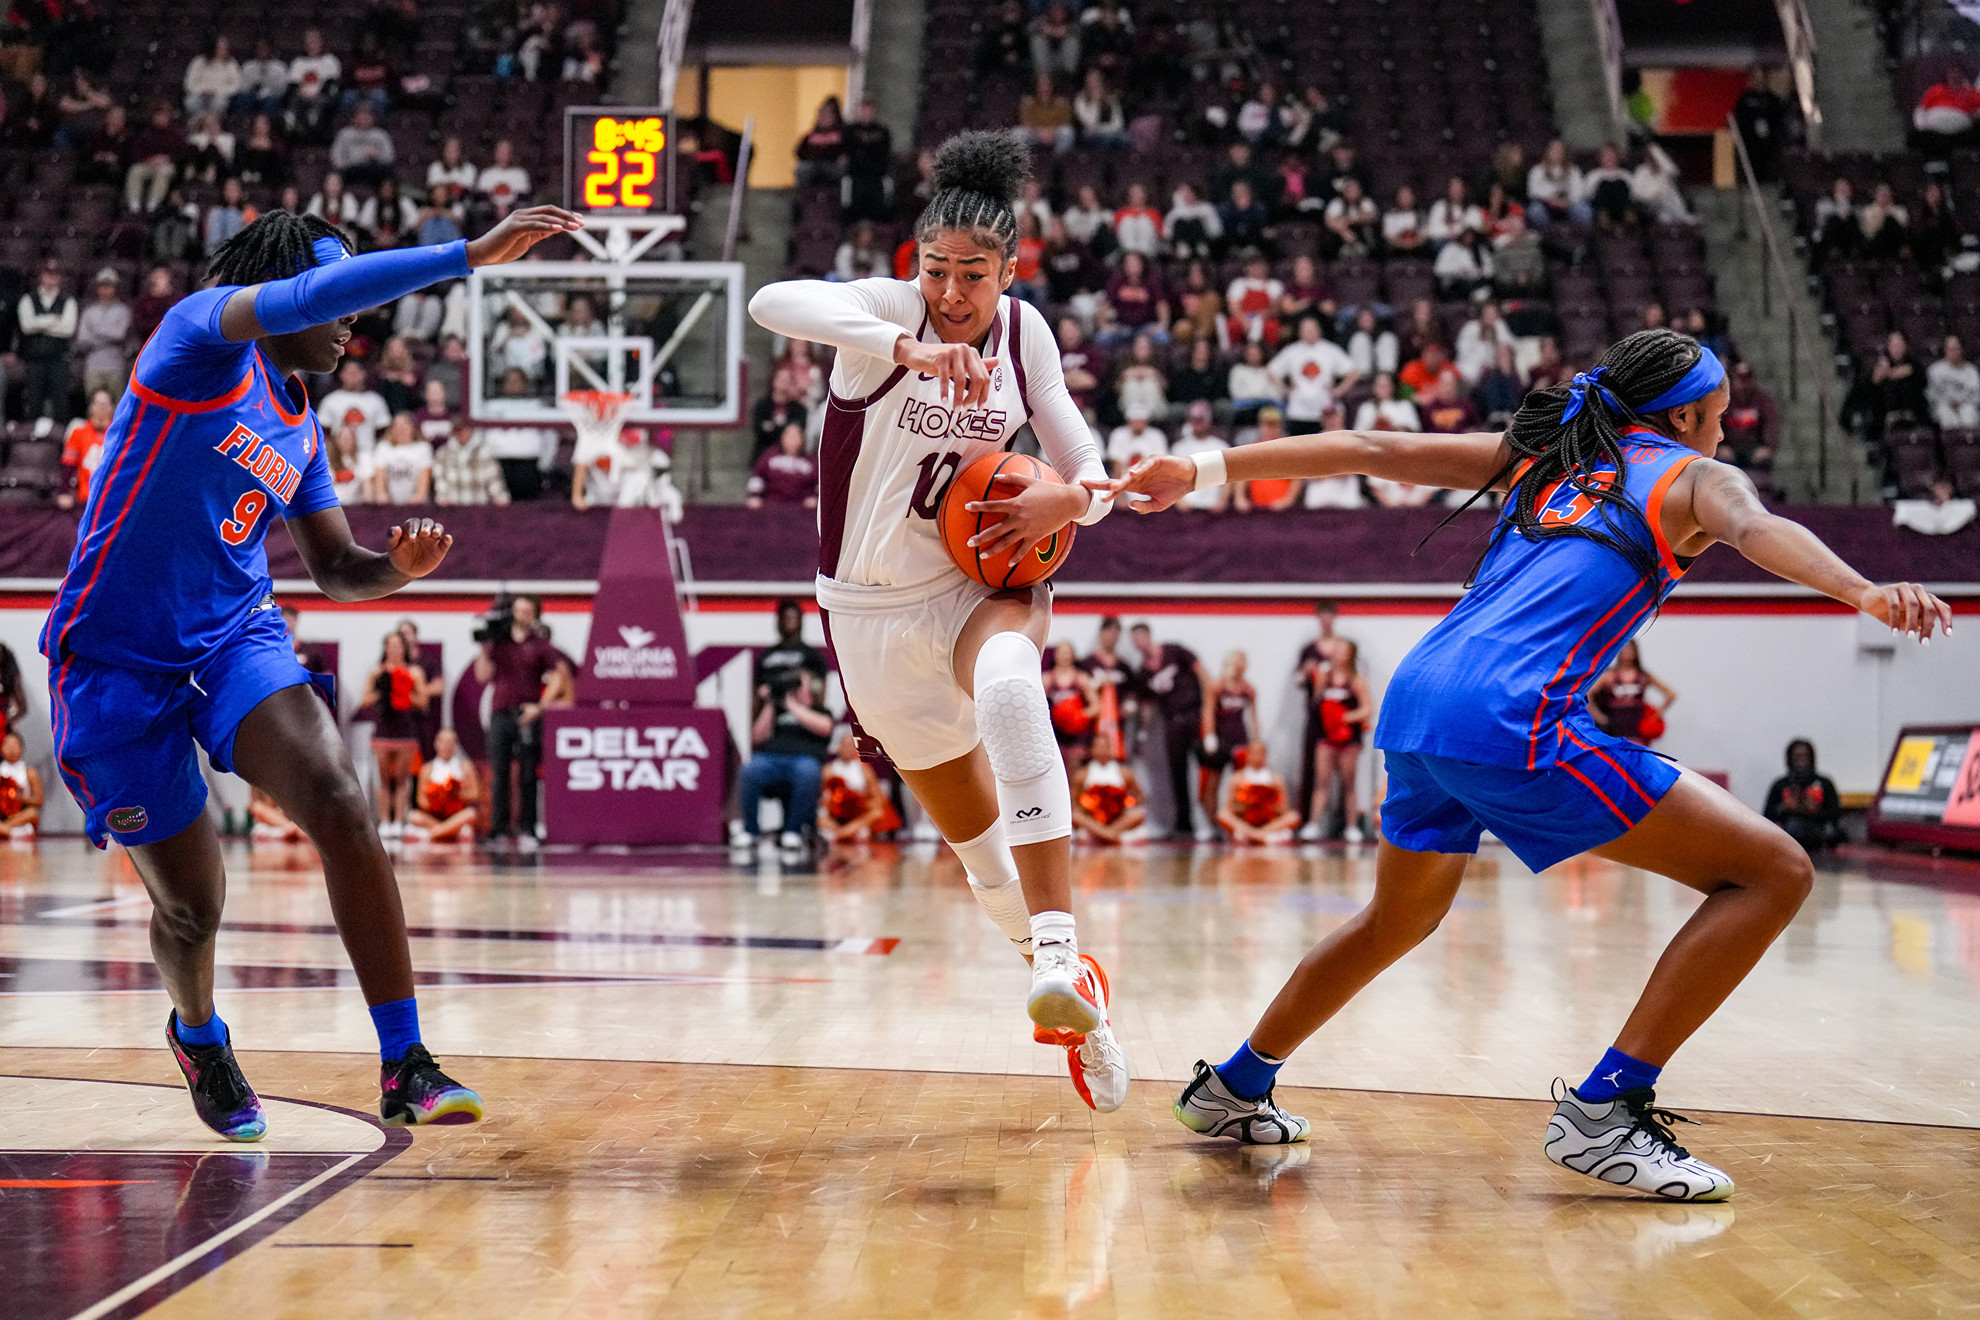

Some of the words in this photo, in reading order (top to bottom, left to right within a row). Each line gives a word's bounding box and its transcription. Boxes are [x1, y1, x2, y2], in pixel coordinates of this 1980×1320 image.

[594, 117, 665, 153] 8:45
[584, 150, 656, 208] 22
[213, 421, 302, 506] FLORID
[906, 451, 962, 519] 10
[220, 489, 267, 546] 9
[556, 726, 710, 759] DELTA
[567, 759, 700, 791] STAR
